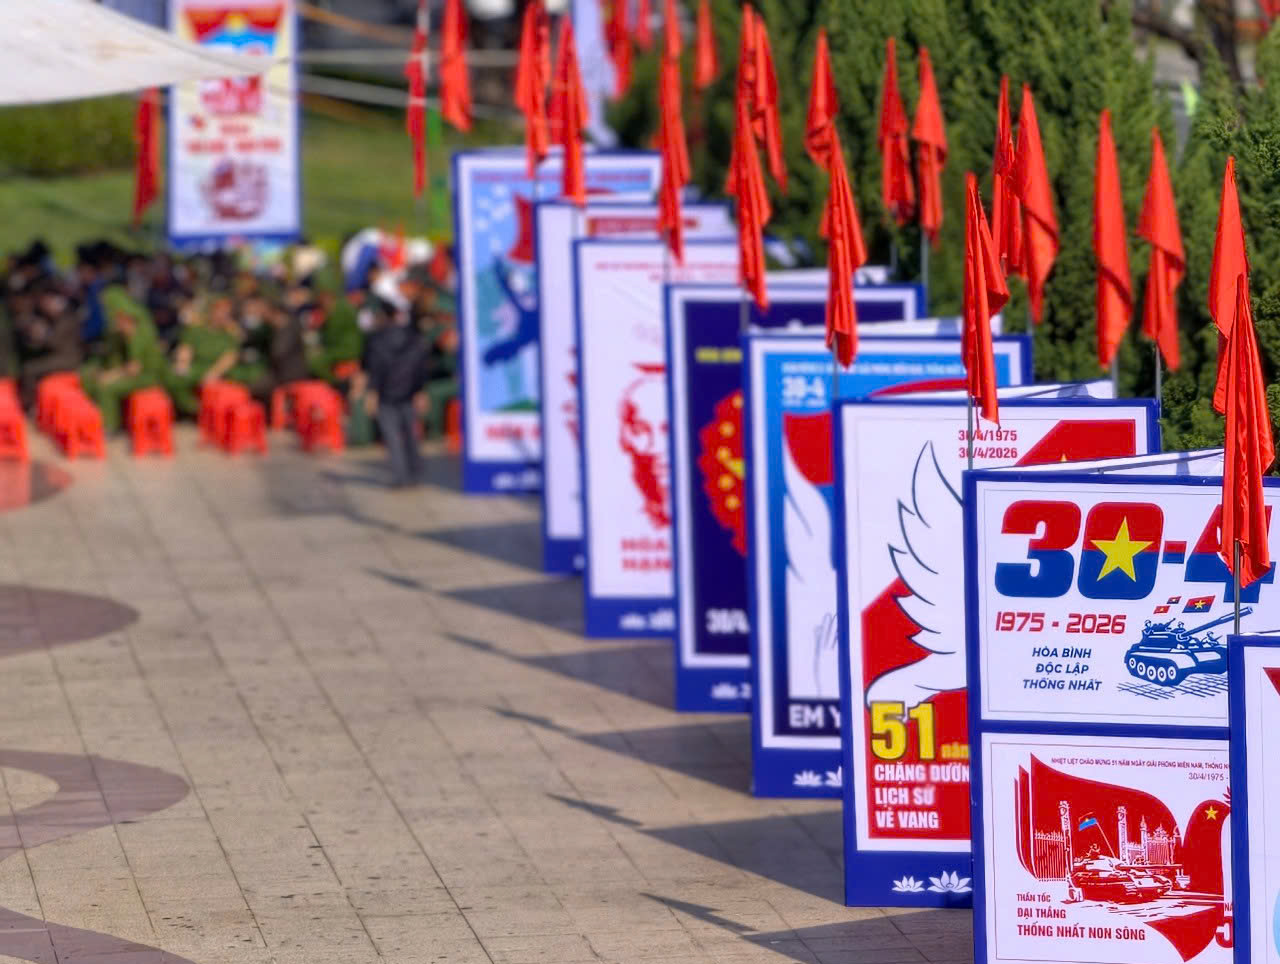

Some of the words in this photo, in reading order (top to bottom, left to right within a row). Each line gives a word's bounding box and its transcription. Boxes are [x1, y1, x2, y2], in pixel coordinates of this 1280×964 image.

[959, 430, 1017, 441] 3//1975
[994, 500, 1276, 603] 30-4
[995, 611, 1045, 632] 1975
[1066, 613, 1126, 634] 2026
[1032, 646, 1058, 658] HÒA
[1062, 646, 1091, 658] BÌNH
[1036, 662, 1062, 675] ĐỘC
[1066, 662, 1088, 676] LẬP
[1023, 678, 1065, 690] THỐNG
[1068, 678, 1102, 691] NHẤT
[789, 704, 824, 728] EM
[871, 701, 935, 760] 51
[874, 762, 926, 784] CHẶNG
[1189, 773, 1224, 781] 30/4/1975
[875, 787, 909, 808] LỊCH
[897, 811, 939, 829] VANG
[1017, 908, 1032, 919] ĐẠI
[1017, 921, 1052, 936] THỐNG
[1057, 922, 1085, 938] NHẤT
[1088, 927, 1111, 939] NON
[1115, 926, 1145, 940] SÔNG
